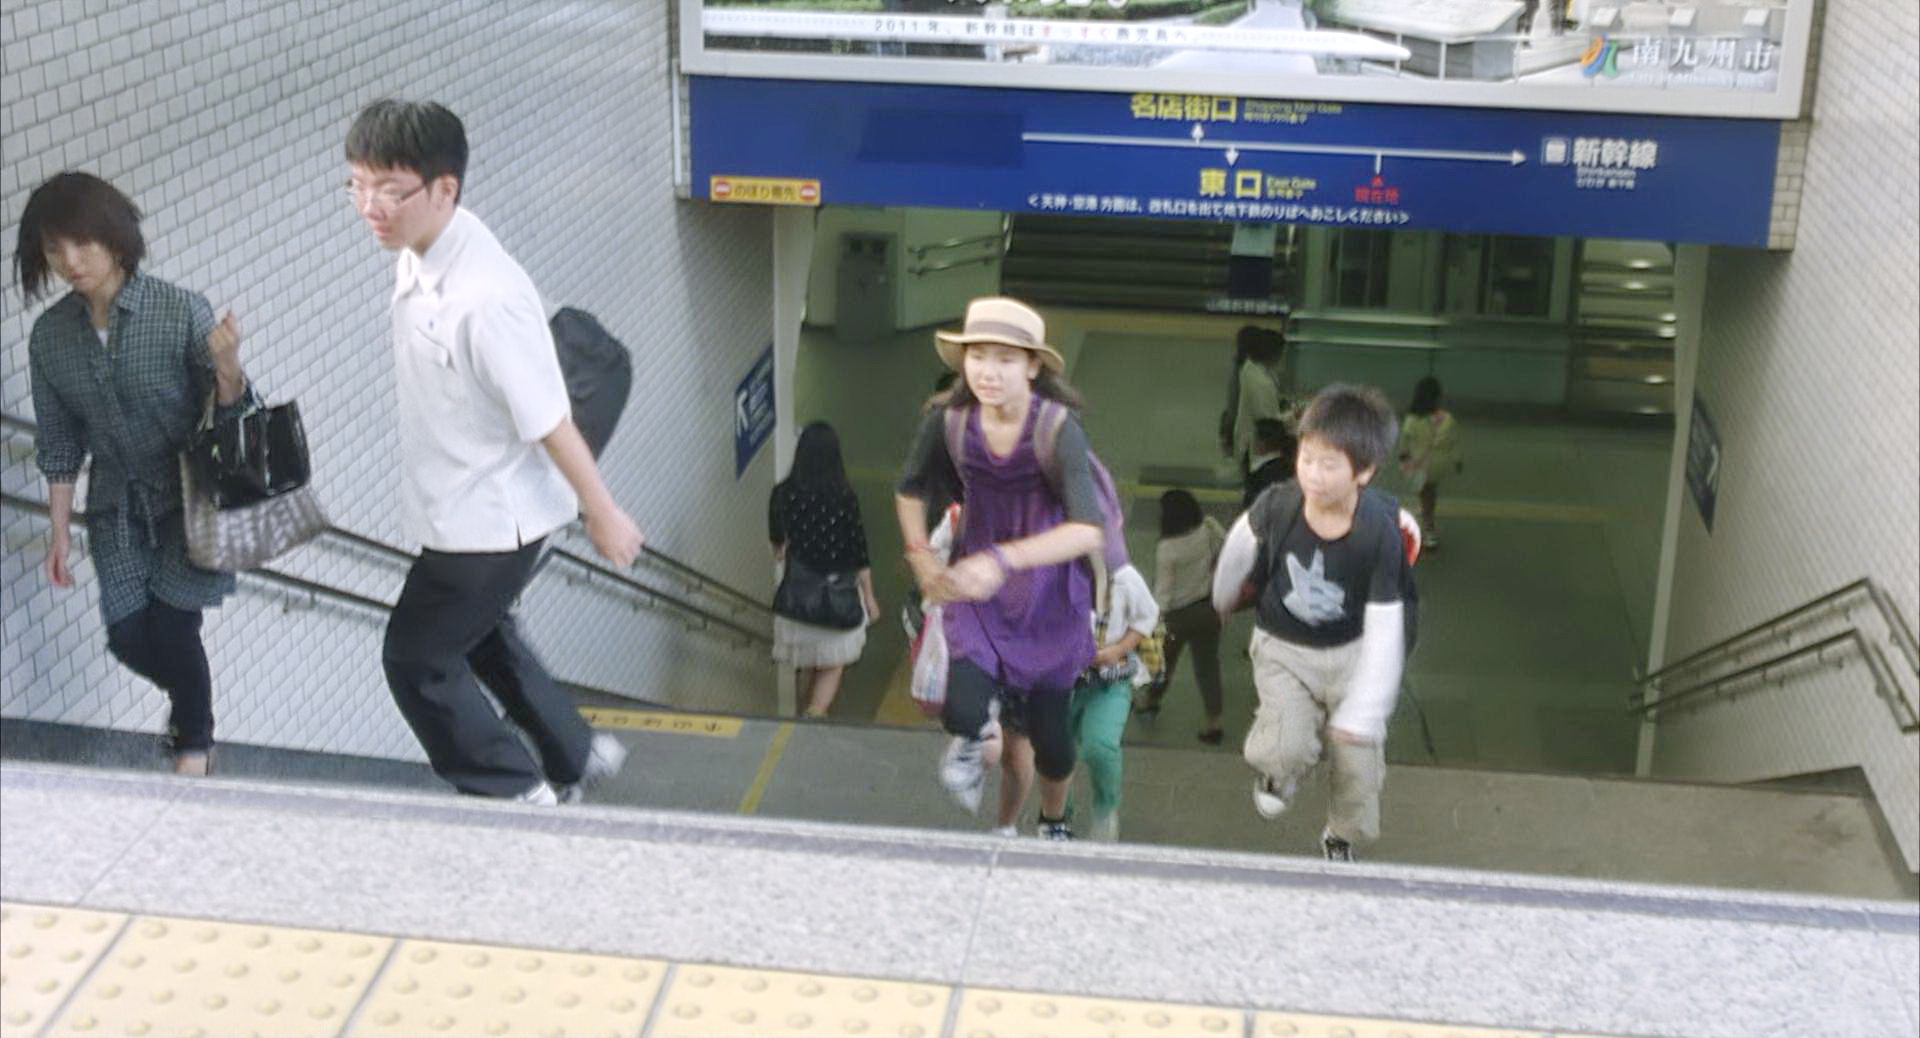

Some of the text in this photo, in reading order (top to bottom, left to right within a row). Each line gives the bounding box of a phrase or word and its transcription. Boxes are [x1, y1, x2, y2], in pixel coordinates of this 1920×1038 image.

[1632, 37, 1775, 71] 南九州市
[1131, 94, 1237, 122] 名店街口
[1573, 137, 1657, 169] 新幹線
[1200, 168, 1263, 199] 東口
